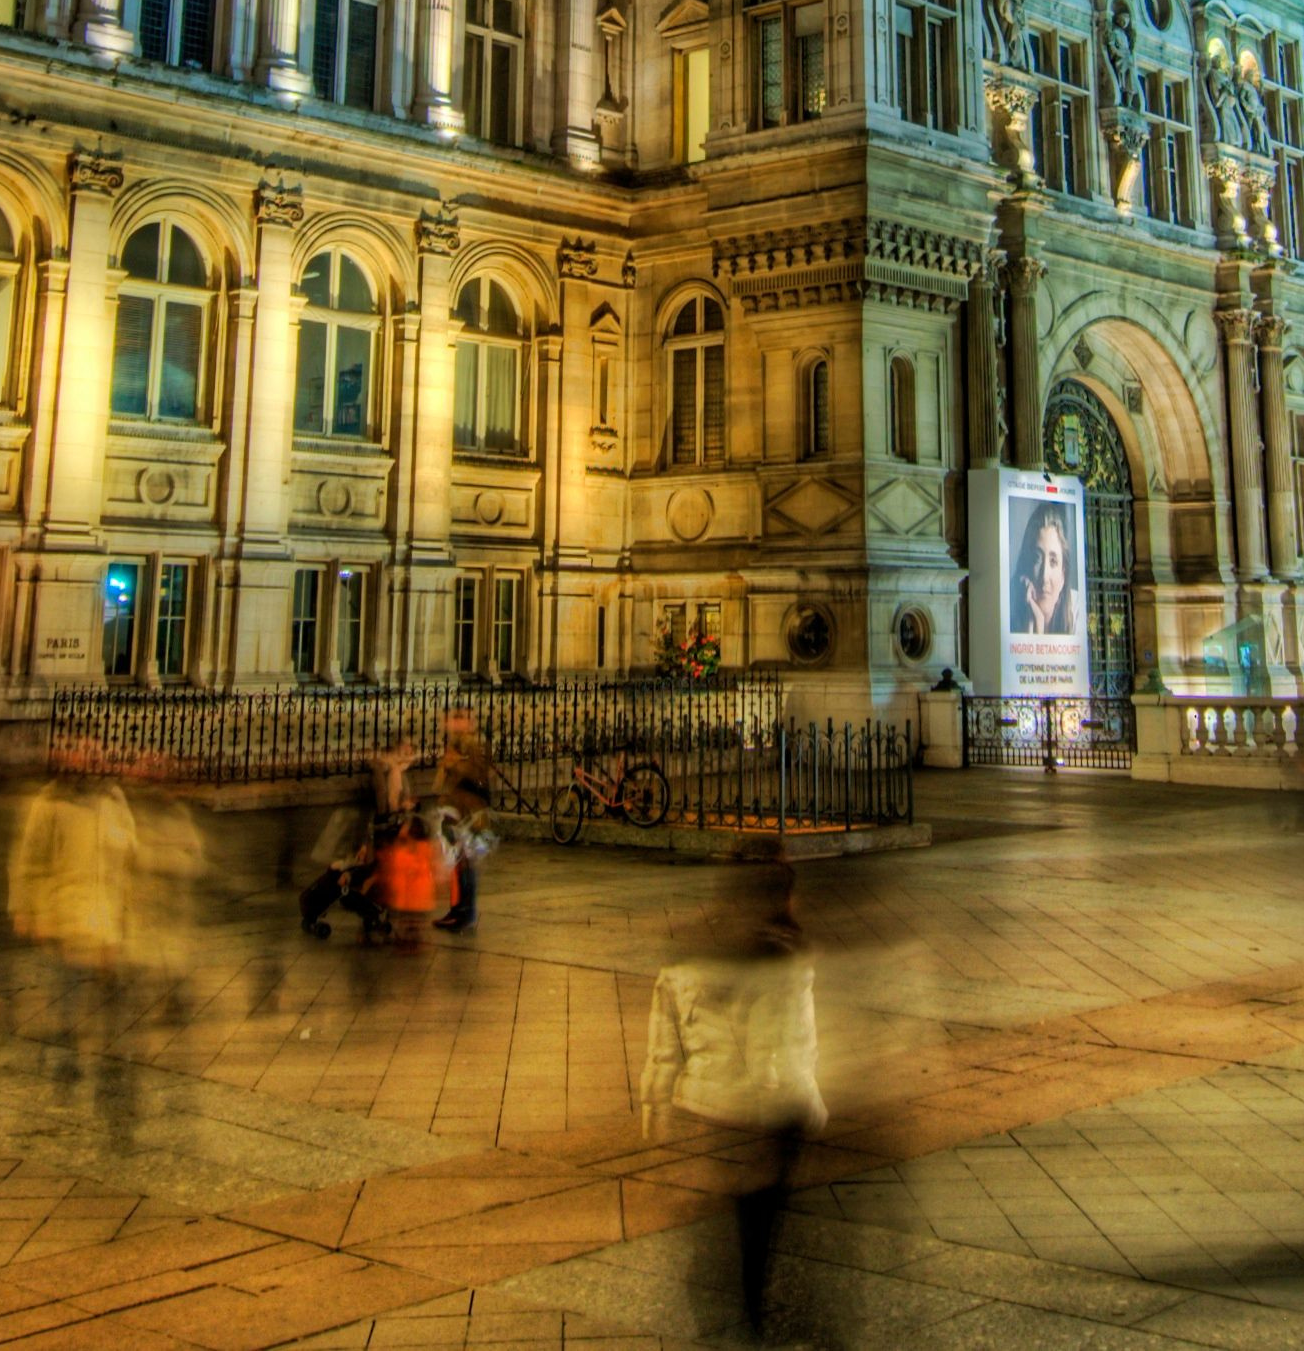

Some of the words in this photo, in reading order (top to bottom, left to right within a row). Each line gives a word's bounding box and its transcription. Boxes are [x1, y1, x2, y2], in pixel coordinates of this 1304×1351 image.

[46, 637, 80, 649] PARIS
[1009, 642, 1034, 655] INGRID
[1035, 643, 1081, 656] BETANCOURT
[1019, 675, 1026, 684] DE
[1028, 675, 1034, 683] LA
[1035, 675, 1049, 684] VILLE
